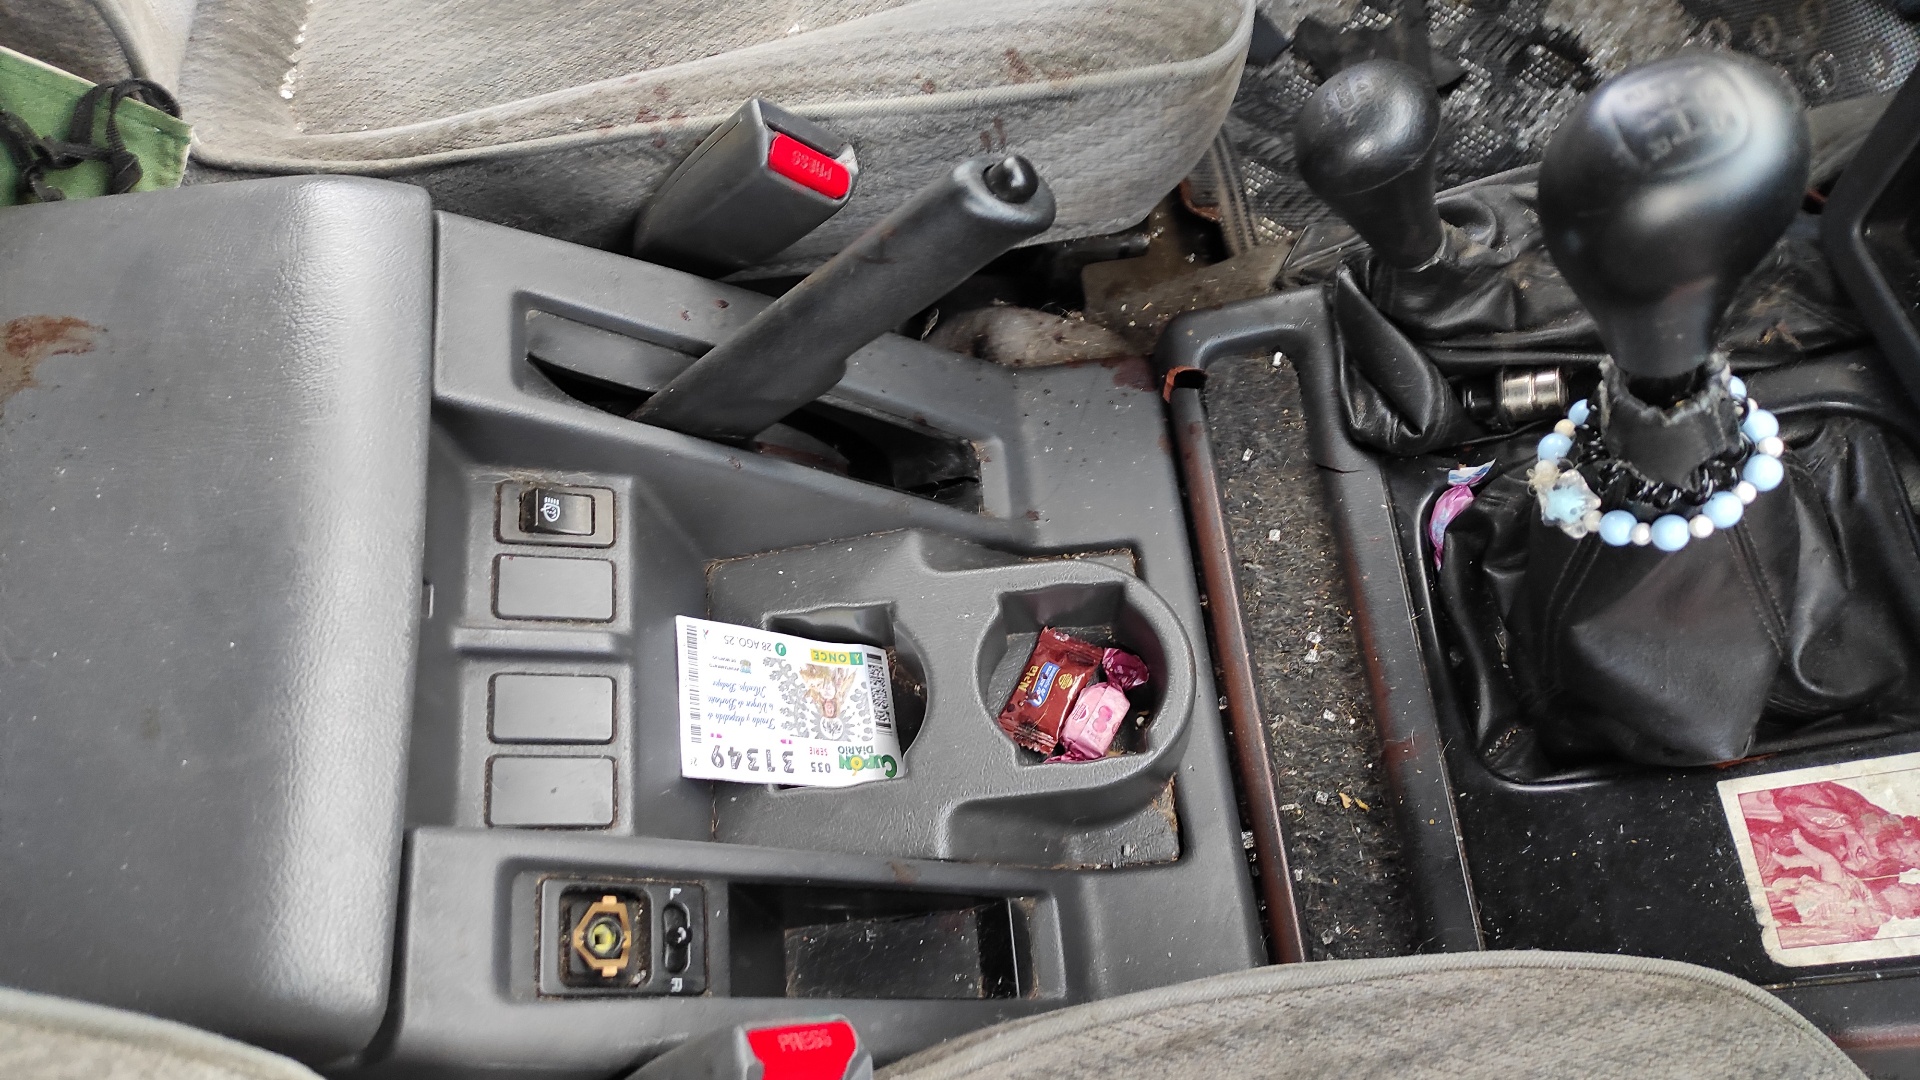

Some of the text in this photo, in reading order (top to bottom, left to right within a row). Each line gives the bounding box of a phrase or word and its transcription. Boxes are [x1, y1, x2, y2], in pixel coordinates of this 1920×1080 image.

[791, 150, 833, 181] PRESS
[723, 635, 735, 646] 25
[762, 641, 772, 652] 28
[813, 650, 848, 663] ONCE
[809, 746, 828, 756] SERIE
[711, 745, 795, 774] 31349
[838, 754, 898, 778] CUPÓN
[810, 761, 831, 773] 035
[669, 887, 682, 900] L
[670, 977, 683, 993] R
[777, 1028, 832, 1052] PRESS
